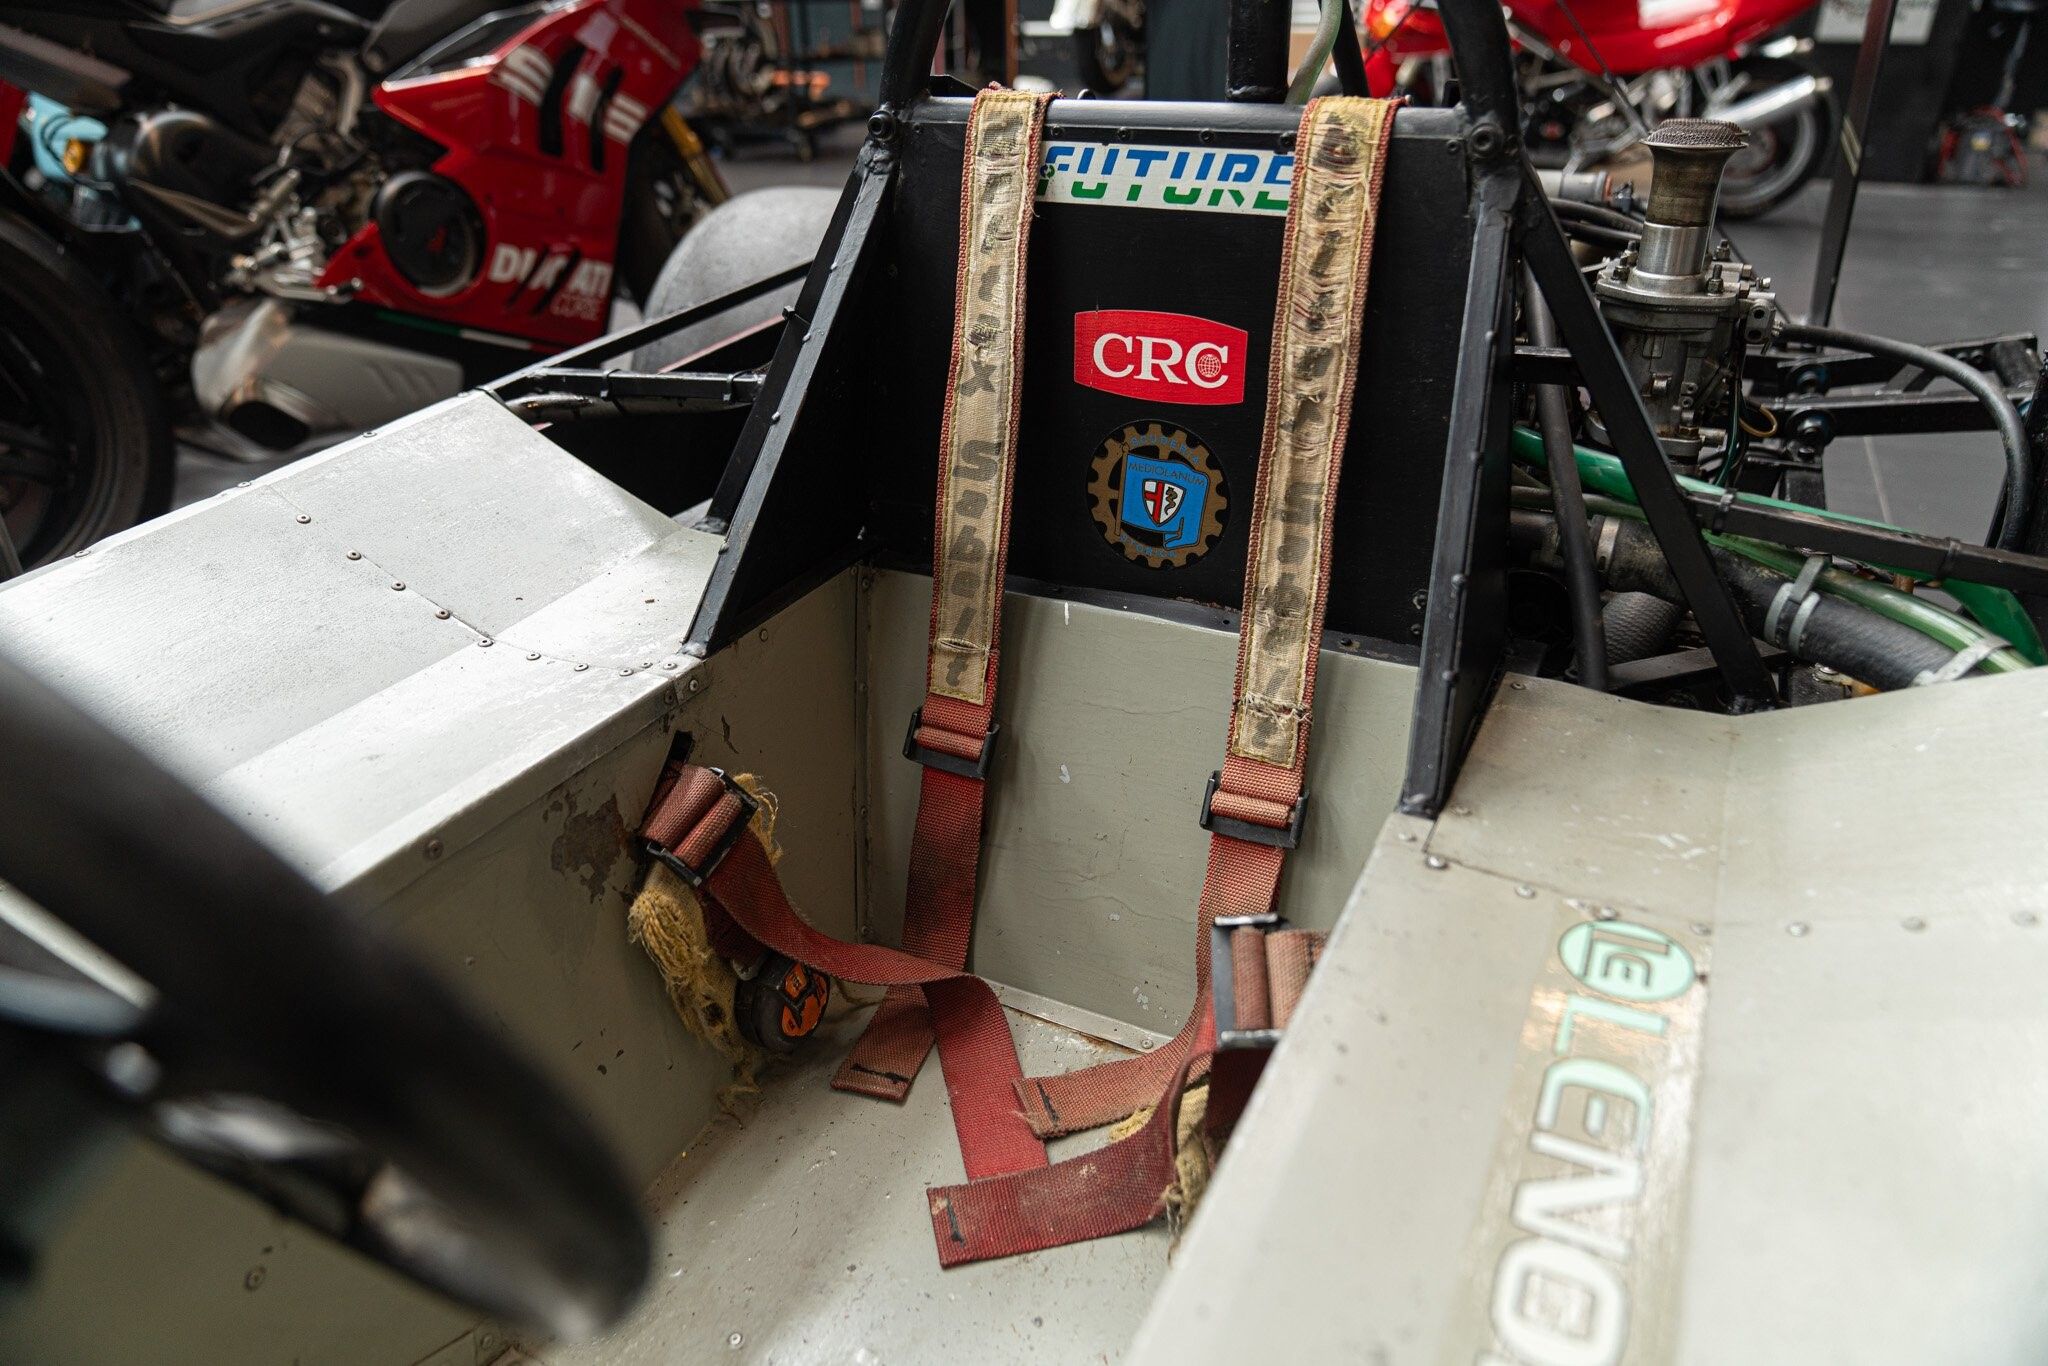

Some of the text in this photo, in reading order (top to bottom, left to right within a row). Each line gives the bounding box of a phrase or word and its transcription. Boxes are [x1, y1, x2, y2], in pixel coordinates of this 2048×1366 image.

[1036, 146, 1295, 211] FUTURE
[1093, 333, 1229, 389] CRC
[1128, 461, 1206, 487] MEDIOLANUM
[1477, 990, 1671, 1366] LENO
